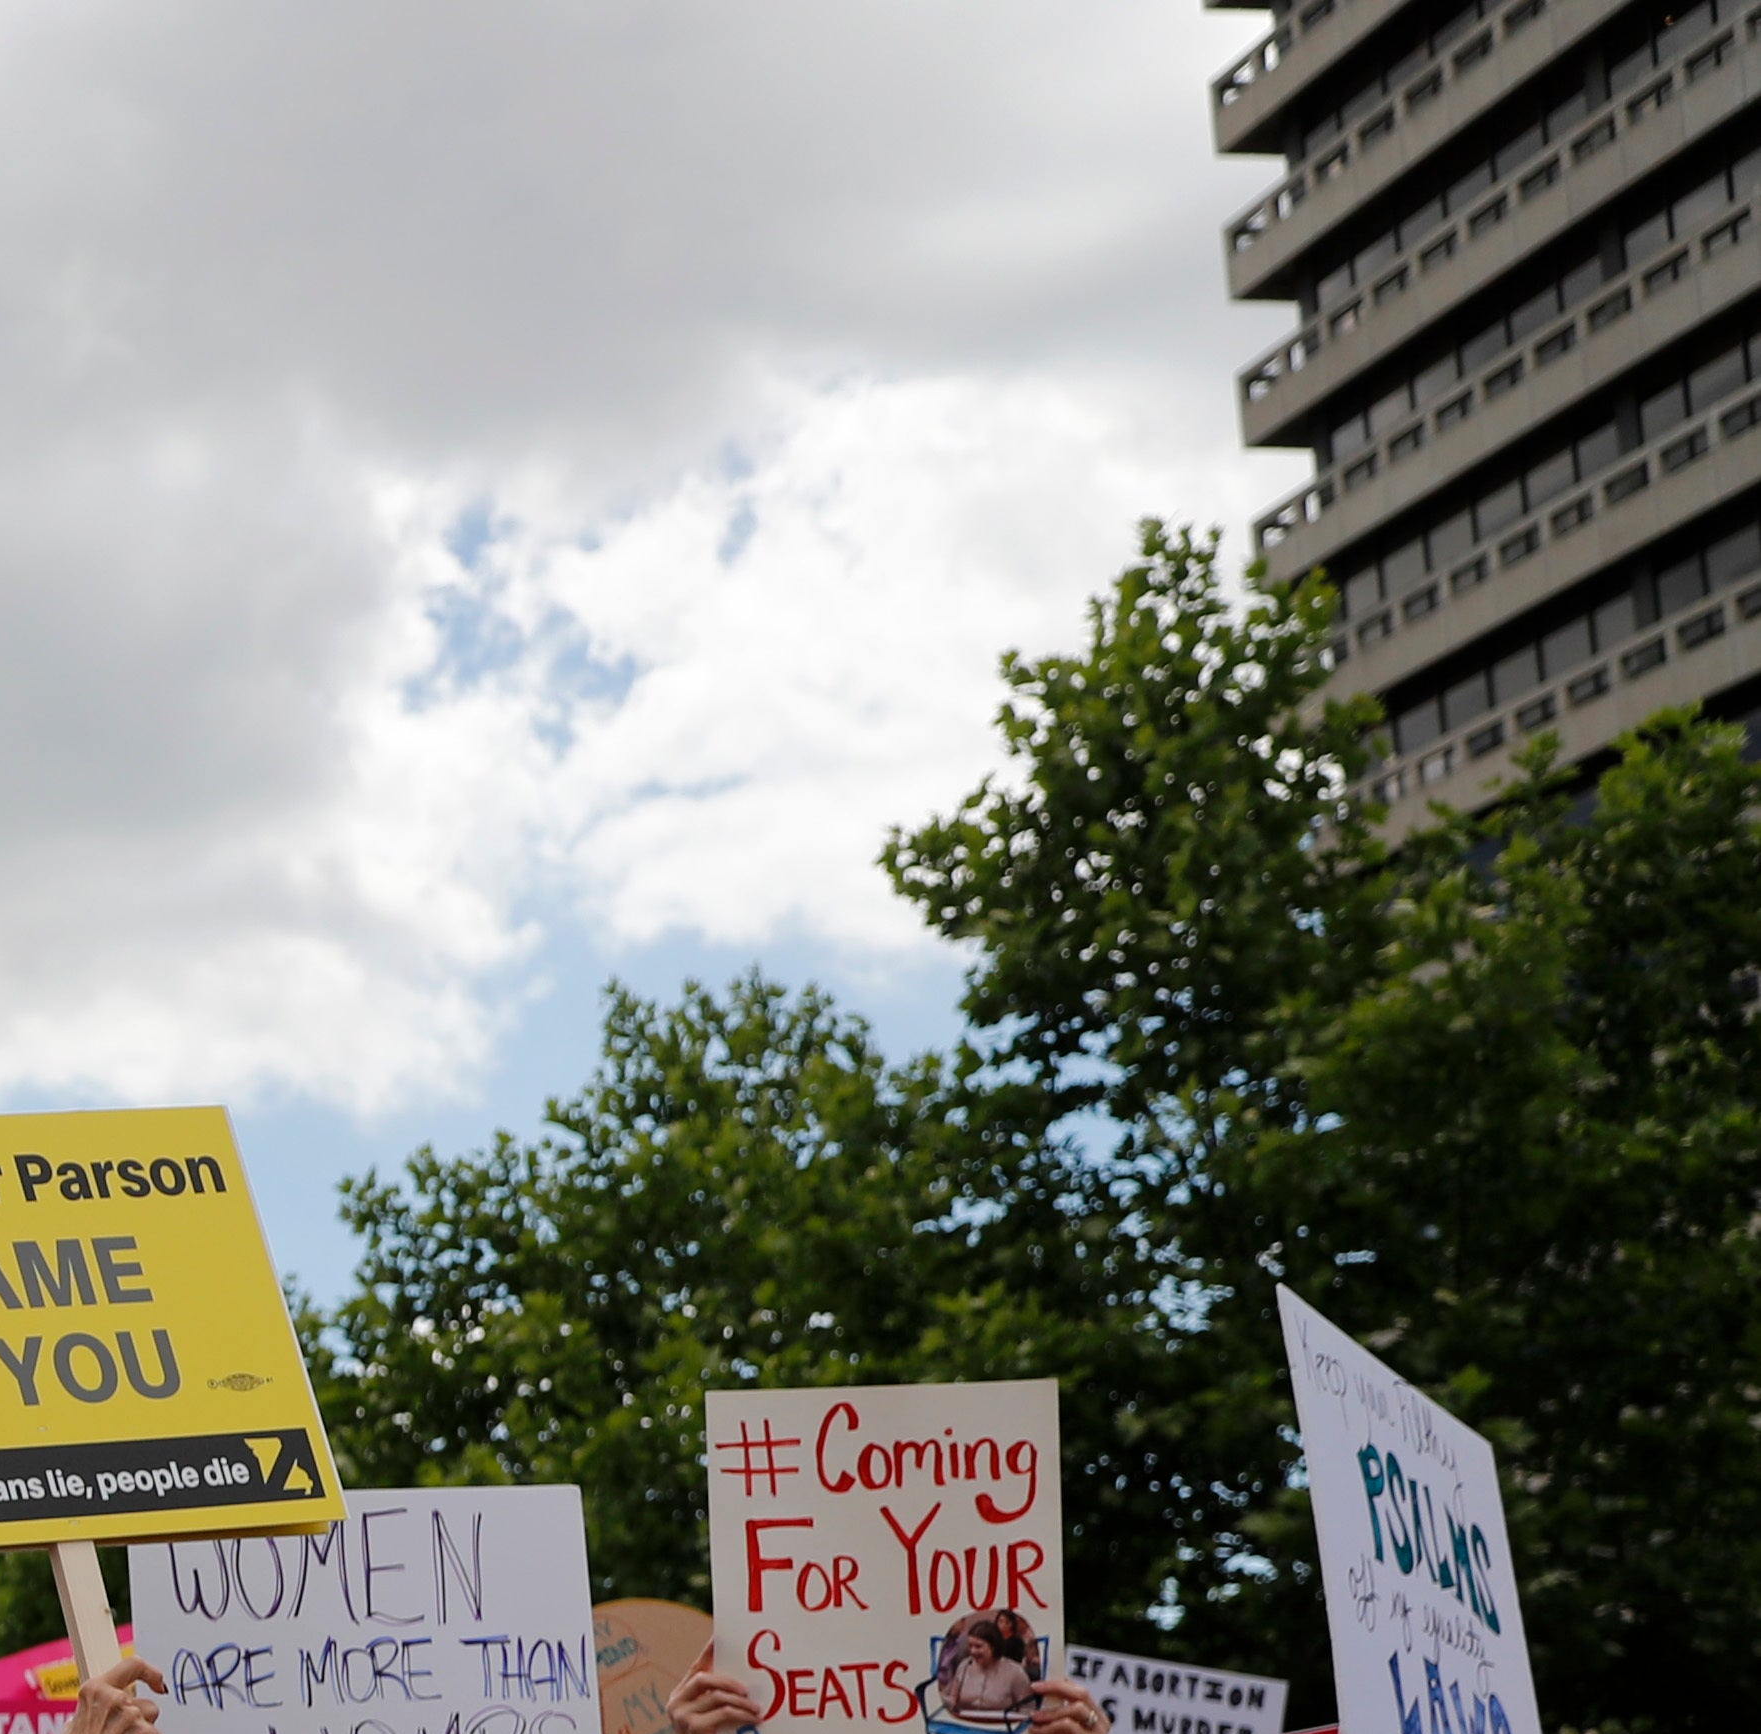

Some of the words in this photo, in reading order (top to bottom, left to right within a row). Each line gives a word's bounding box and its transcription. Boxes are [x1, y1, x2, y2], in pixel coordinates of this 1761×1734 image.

[13, 1153, 228, 1203] Parson
[47, 1469, 94, 1502] lie,
[96, 1459, 200, 1500] people
[202, 1457, 250, 1486] die
[167, 1507, 485, 1625] WOMEN
[880, 1502, 1049, 1615] YOUR
[1357, 1442, 1501, 1636] PSALMS
[172, 1640, 283, 1710] ARE
[299, 1636, 443, 1707] MORE
[459, 1633, 592, 1704] THAN
[746, 1629, 921, 1725] SEATS
[1070, 1654, 1106, 1680] IF
[1111, 1663, 1266, 1710] ABORTION
